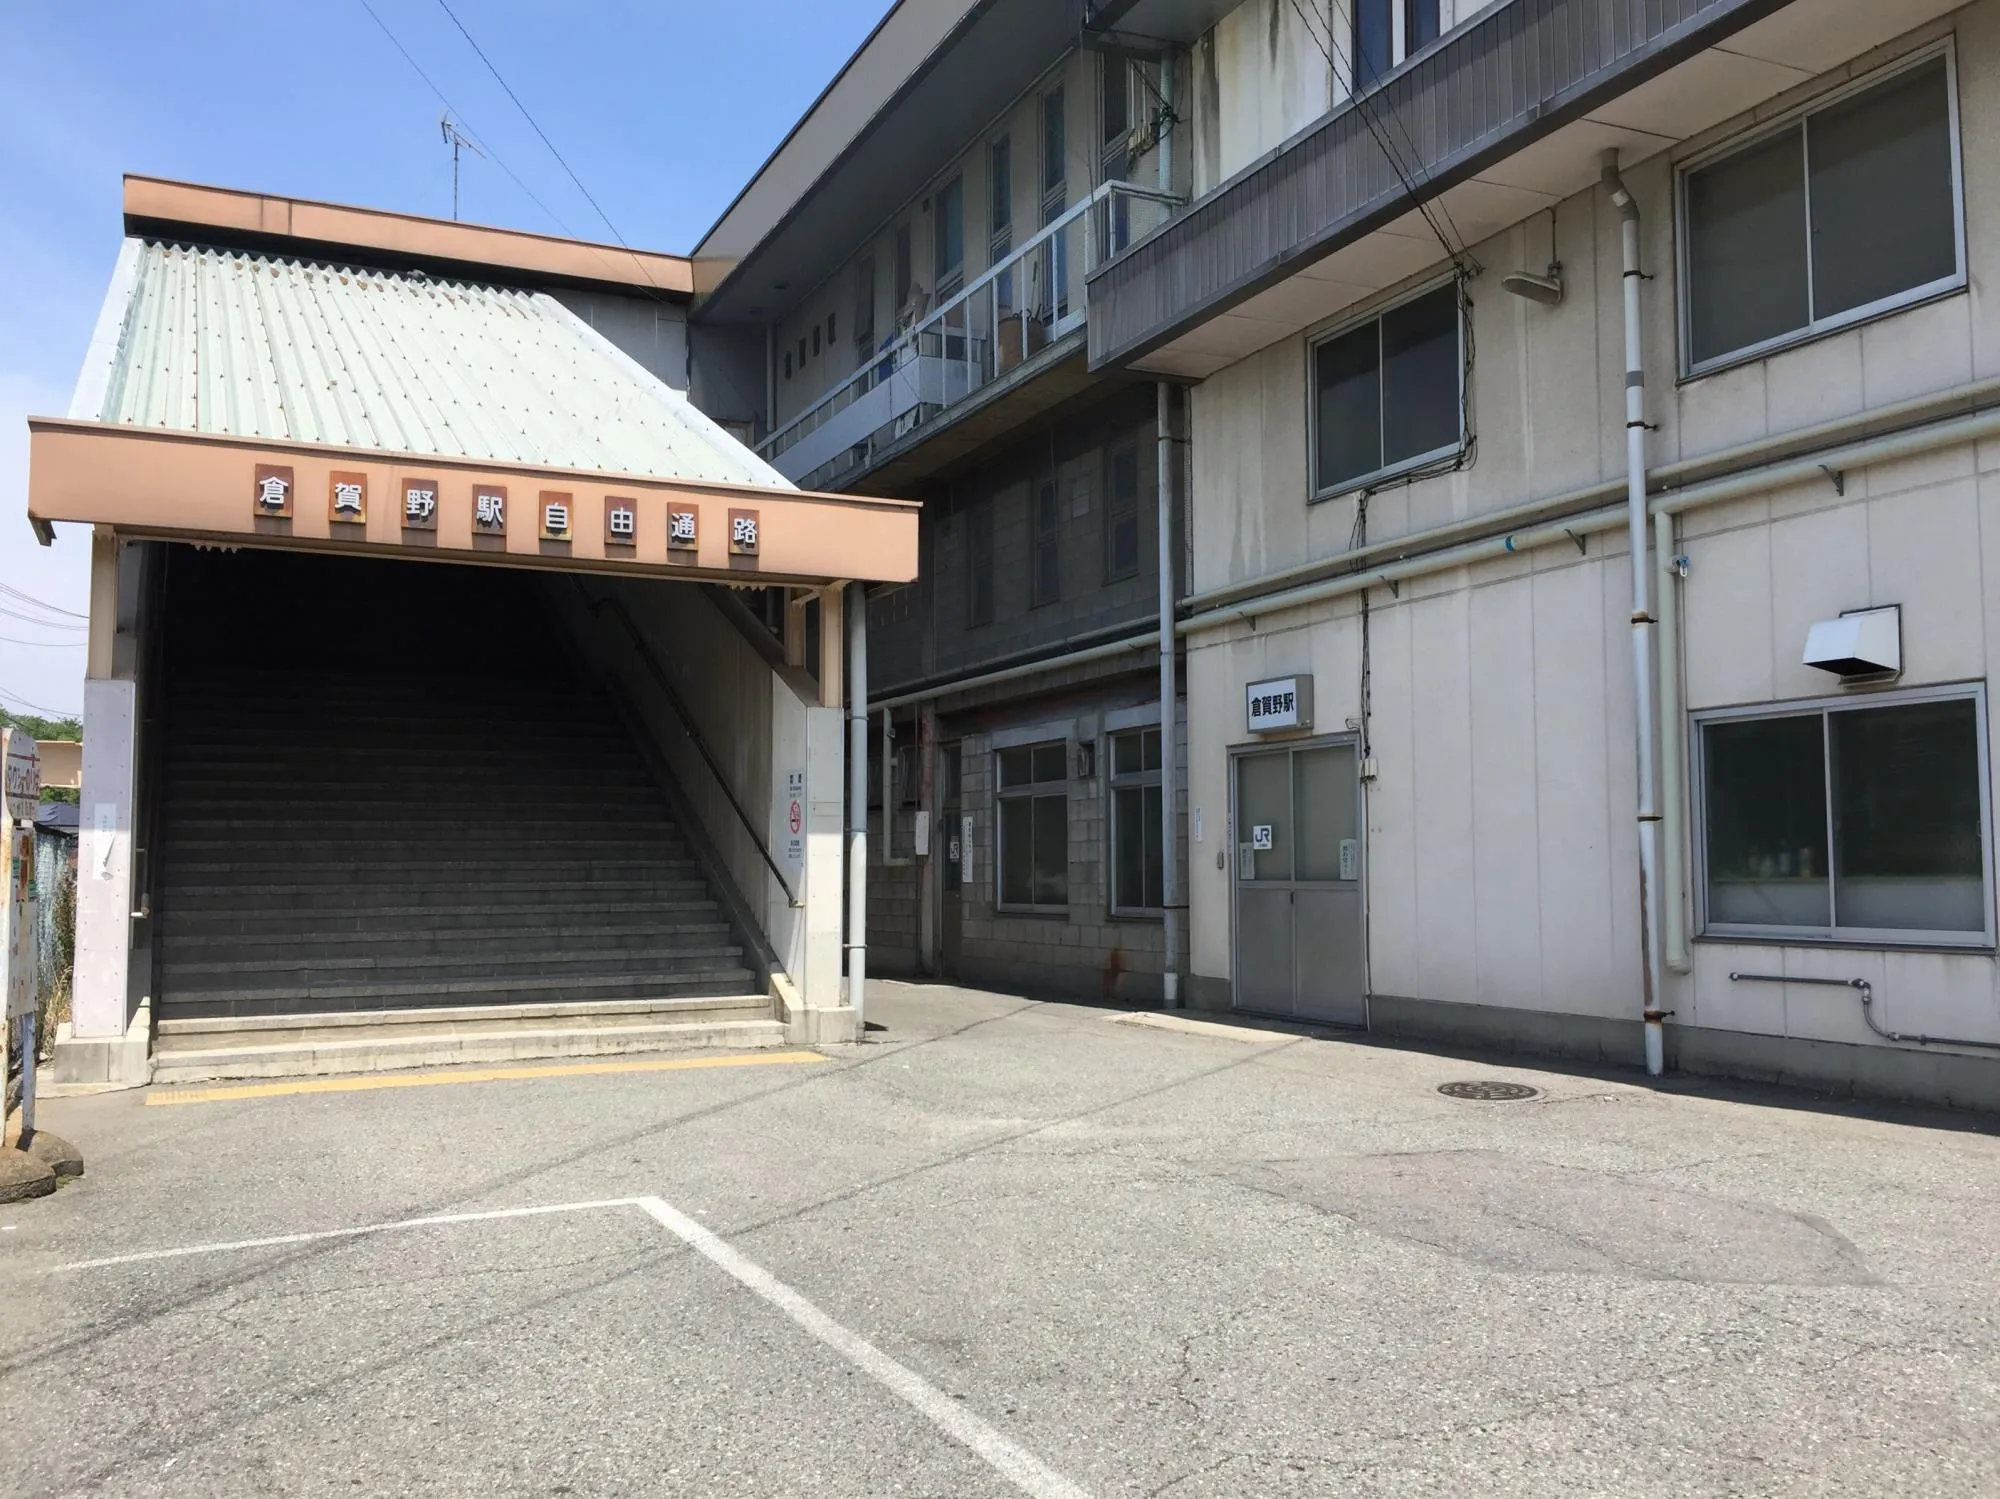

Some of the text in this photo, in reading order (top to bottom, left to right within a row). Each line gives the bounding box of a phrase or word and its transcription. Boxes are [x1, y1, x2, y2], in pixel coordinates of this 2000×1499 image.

[258, 475, 758, 545] 倉賀野駅自由通路
[1251, 692, 1294, 717] 倉賀野駅
[1255, 827, 1270, 843] JR
